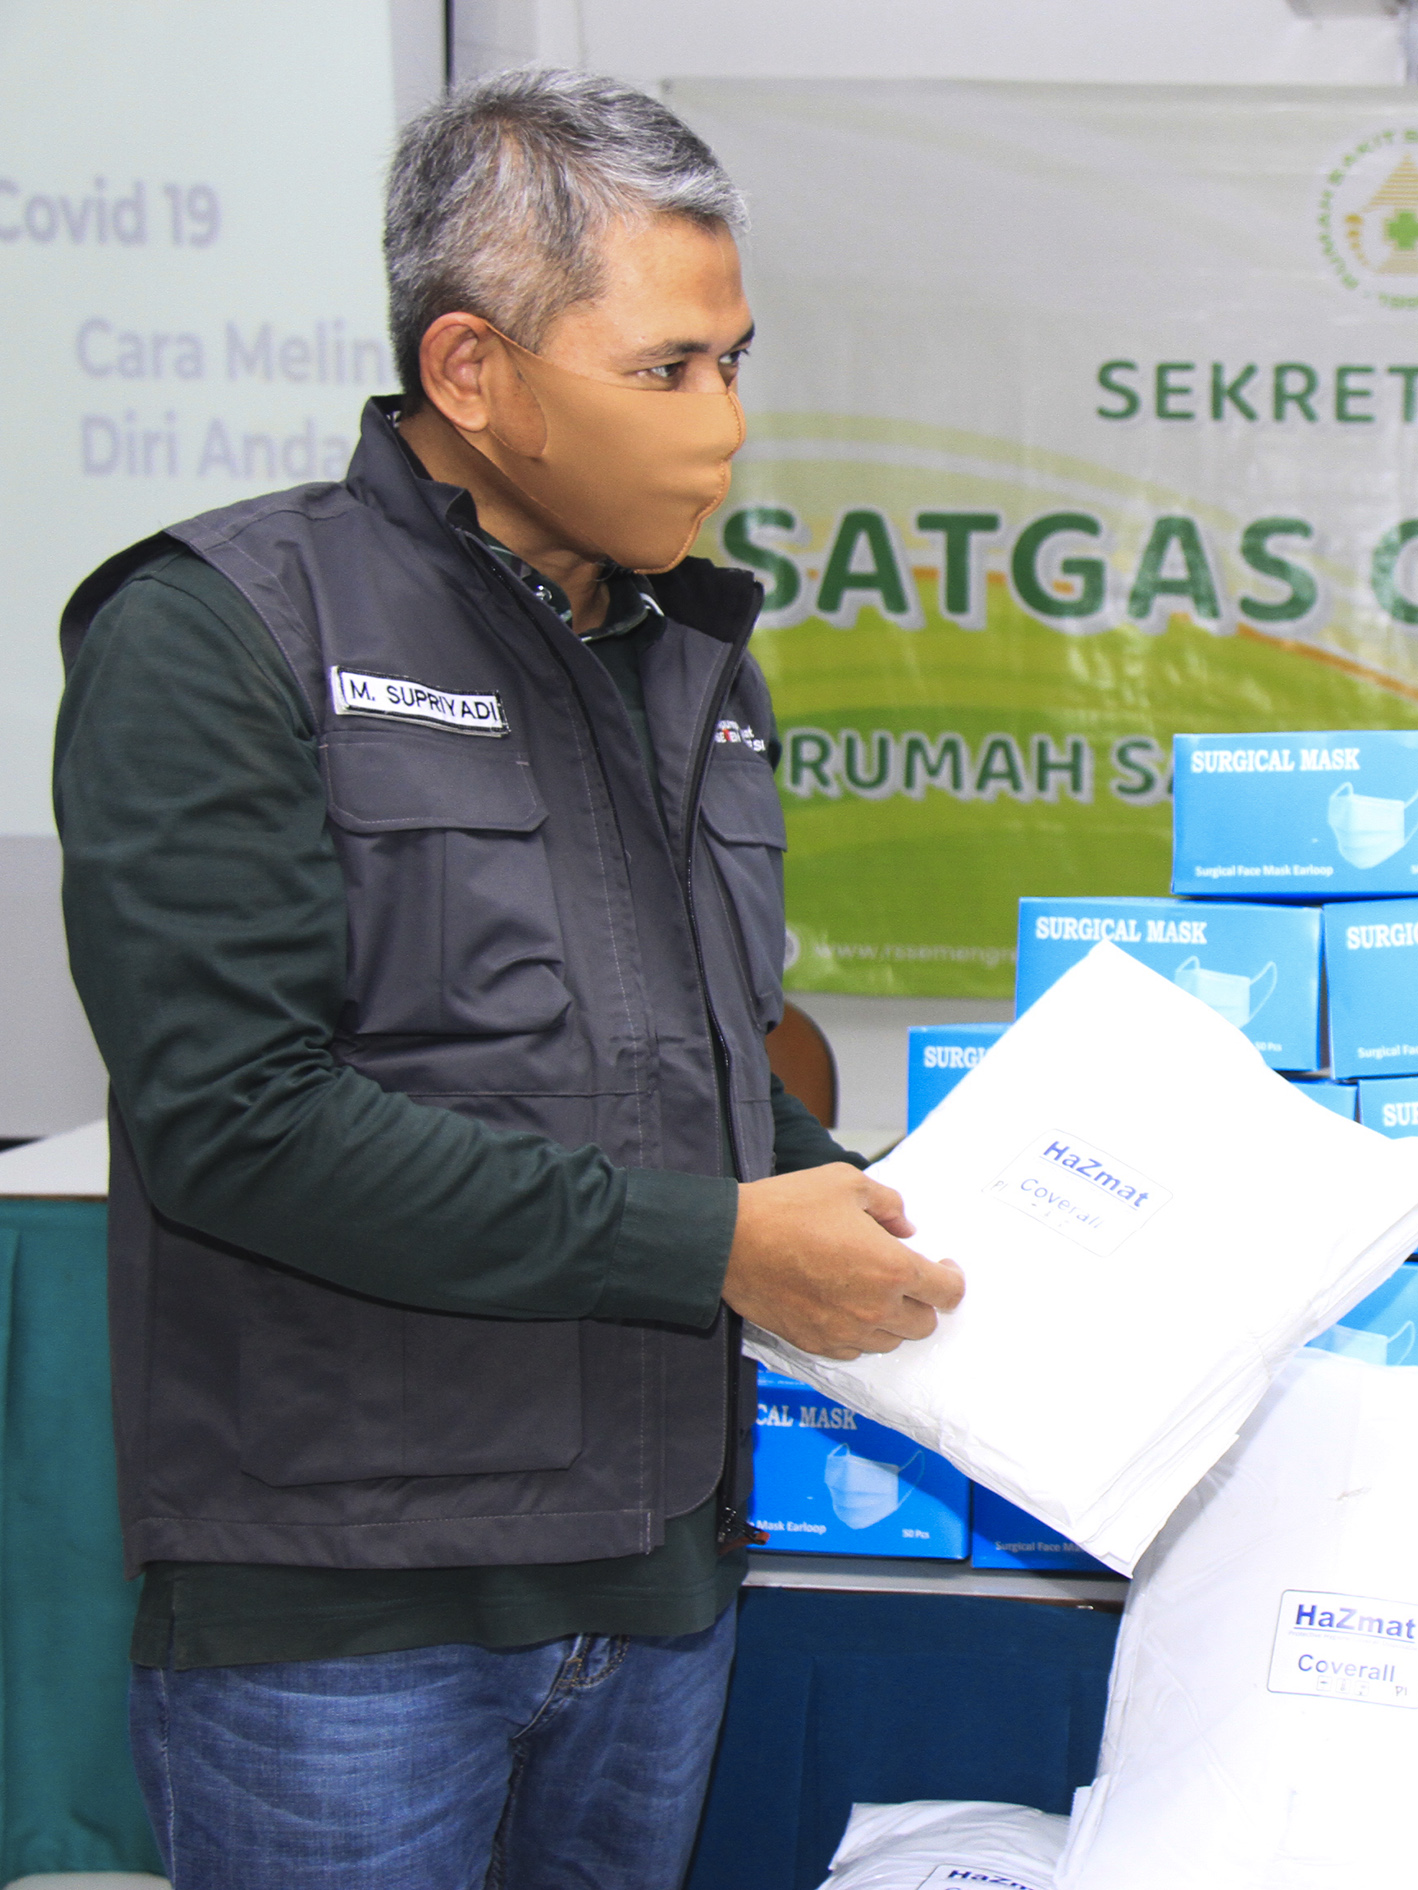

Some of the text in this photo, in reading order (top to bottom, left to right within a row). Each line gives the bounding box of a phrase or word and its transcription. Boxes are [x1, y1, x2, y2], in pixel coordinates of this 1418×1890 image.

[163, 181, 222, 249] 19
[76, 316, 401, 387] Cara Melin
[81, 408, 352, 481] Diri Anda
[722, 506, 1319, 623] SATGAS
[350, 680, 376, 702] M.
[789, 732, 1085, 794] RUMAH
[1191, 748, 1360, 773] SURGICAL MASK
[1195, 864, 1334, 879] Surgical Face Mask Earloop
[1036, 917, 1207, 944] SURGICAL MASK
[1358, 1045, 1400, 1058] Surgical
[1043, 1141, 1149, 1207] HaZmat
[1020, 1178, 1104, 1229] Coverall
[799, 1406, 858, 1430] MASK
[756, 1520, 785, 1531] Mask
[786, 1521, 826, 1535] Earloop
[995, 1541, 1035, 1553] Surgical
[1038, 1542, 1060, 1552] Face
[1296, 1604, 1416, 1639] HaZmat
[1298, 1654, 1395, 1682] Coverall
